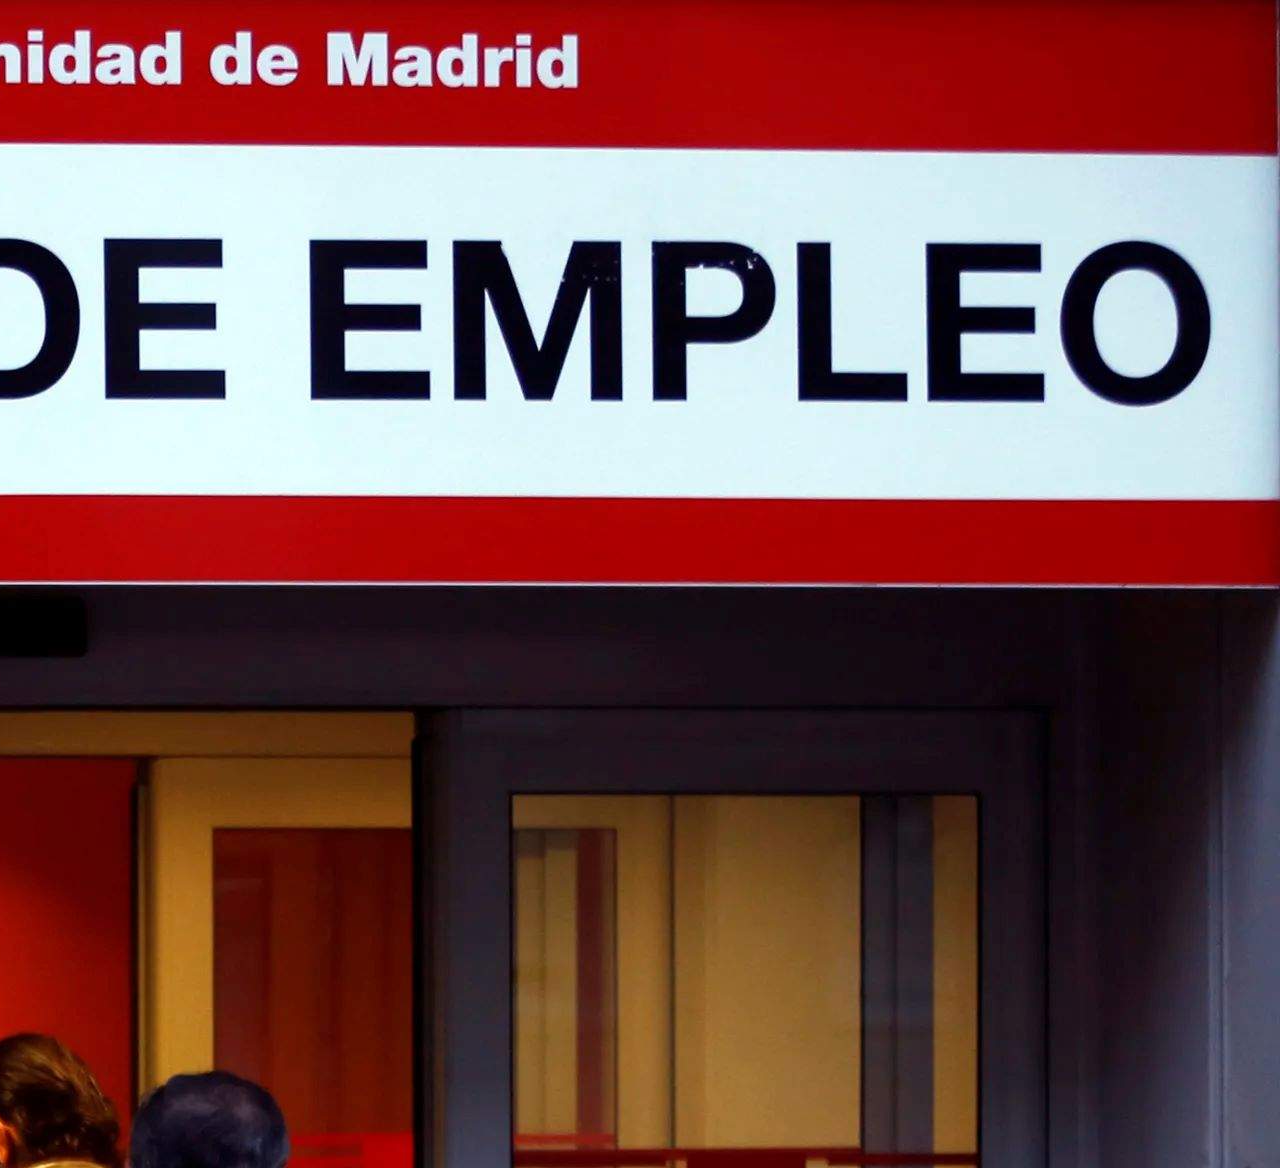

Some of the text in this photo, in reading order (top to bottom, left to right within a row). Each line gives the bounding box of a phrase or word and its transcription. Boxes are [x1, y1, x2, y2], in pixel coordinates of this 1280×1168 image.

[208, 30, 300, 87] de
[325, 31, 579, 90] Madrid
[308, 238, 1213, 408] EMPLEO
